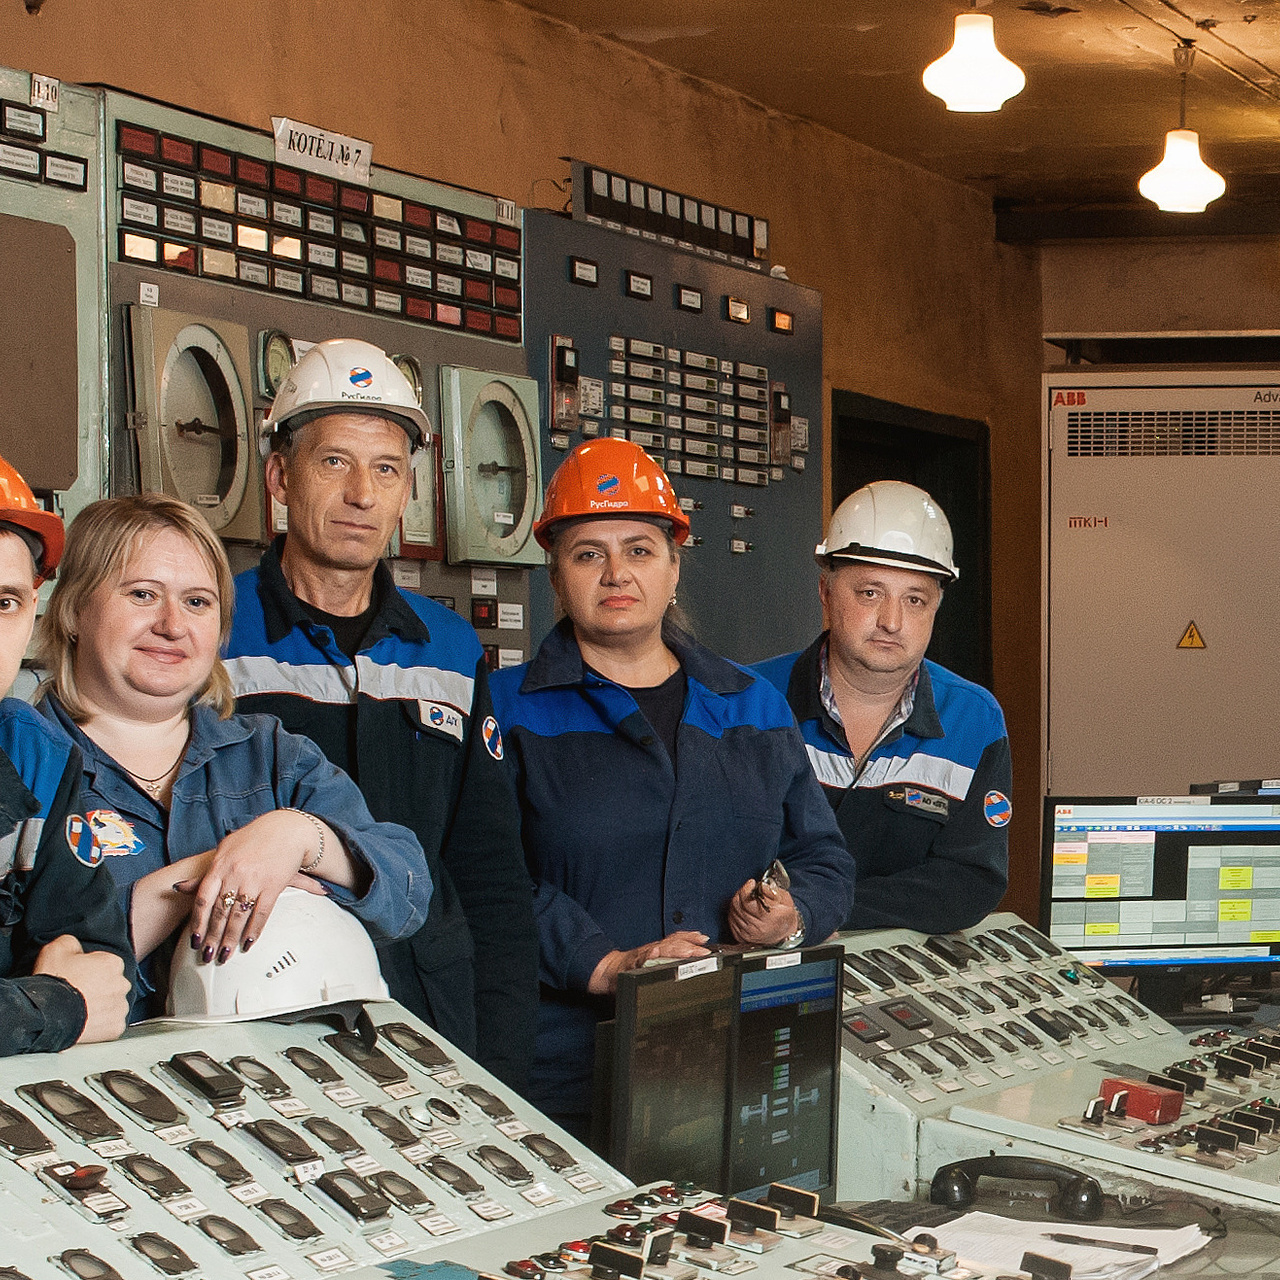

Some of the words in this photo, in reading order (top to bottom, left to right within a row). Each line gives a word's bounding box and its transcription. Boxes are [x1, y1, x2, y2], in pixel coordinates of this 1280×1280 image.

[287, 129, 335, 162] КОТЁЛ
[335, 143, 351, 166] №
[353, 148, 362, 168] 7
[1053, 392, 1087, 406] ABB
